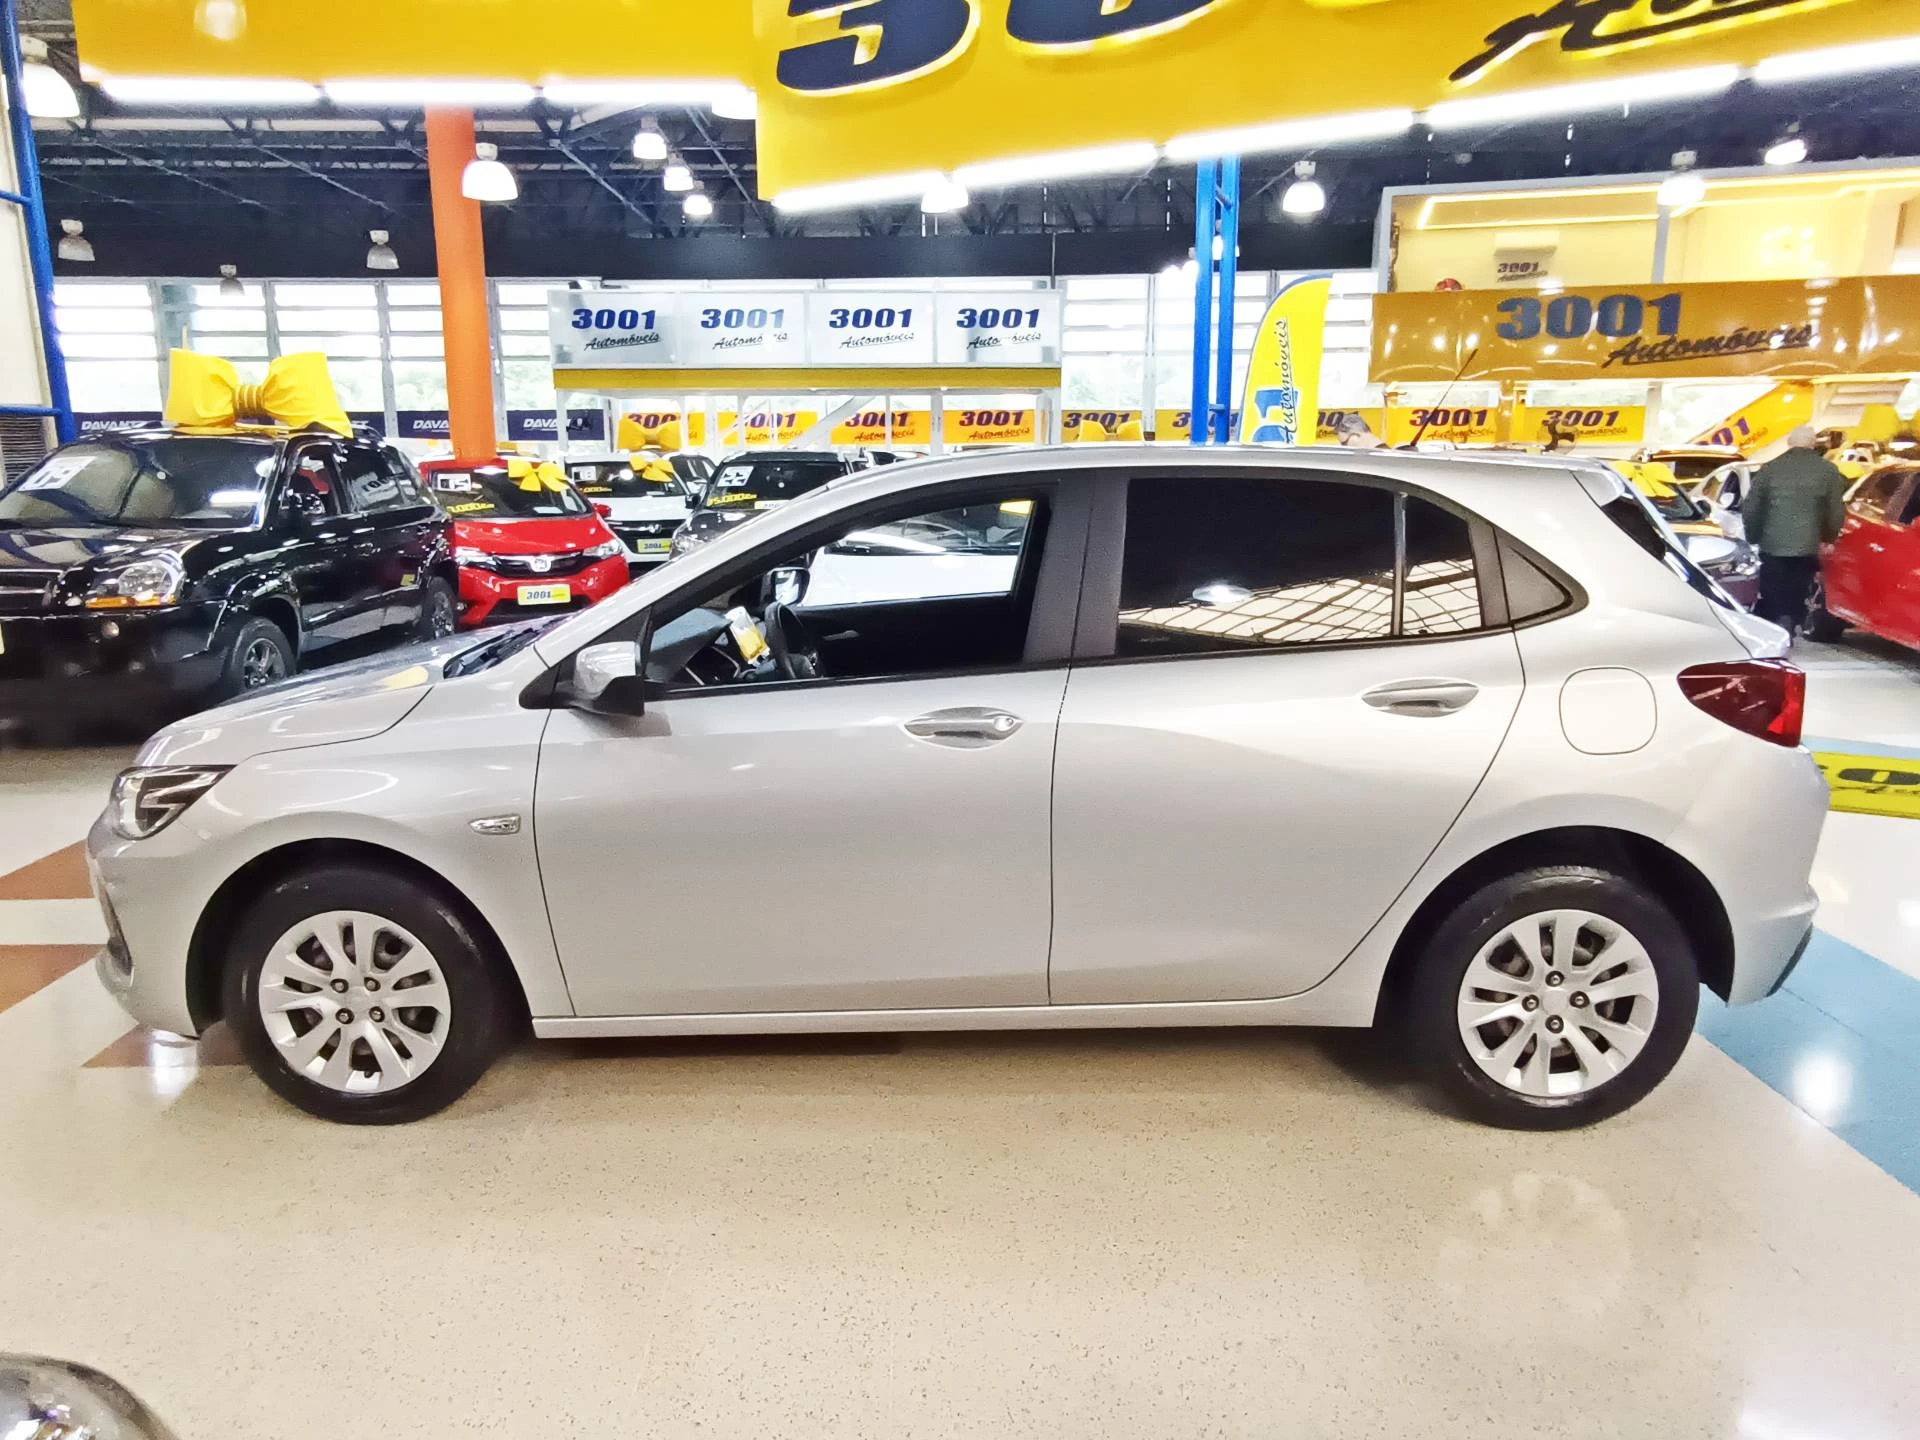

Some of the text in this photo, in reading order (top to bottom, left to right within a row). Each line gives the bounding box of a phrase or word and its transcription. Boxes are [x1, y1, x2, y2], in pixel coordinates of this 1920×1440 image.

[571, 308, 656, 330] 3001
[701, 308, 785, 329] 3001
[829, 308, 913, 329] 3001
[956, 308, 1040, 329] 3001
[1495, 292, 1682, 340] 3001
[584, 332, 661, 350] Automóveis
[839, 332, 915, 349] Automóveis
[1601, 324, 1818, 368] Automóveis
[959, 410, 1024, 427] 3001
[1409, 408, 1488, 427] 3001
[1542, 409, 1620, 427] 3001
